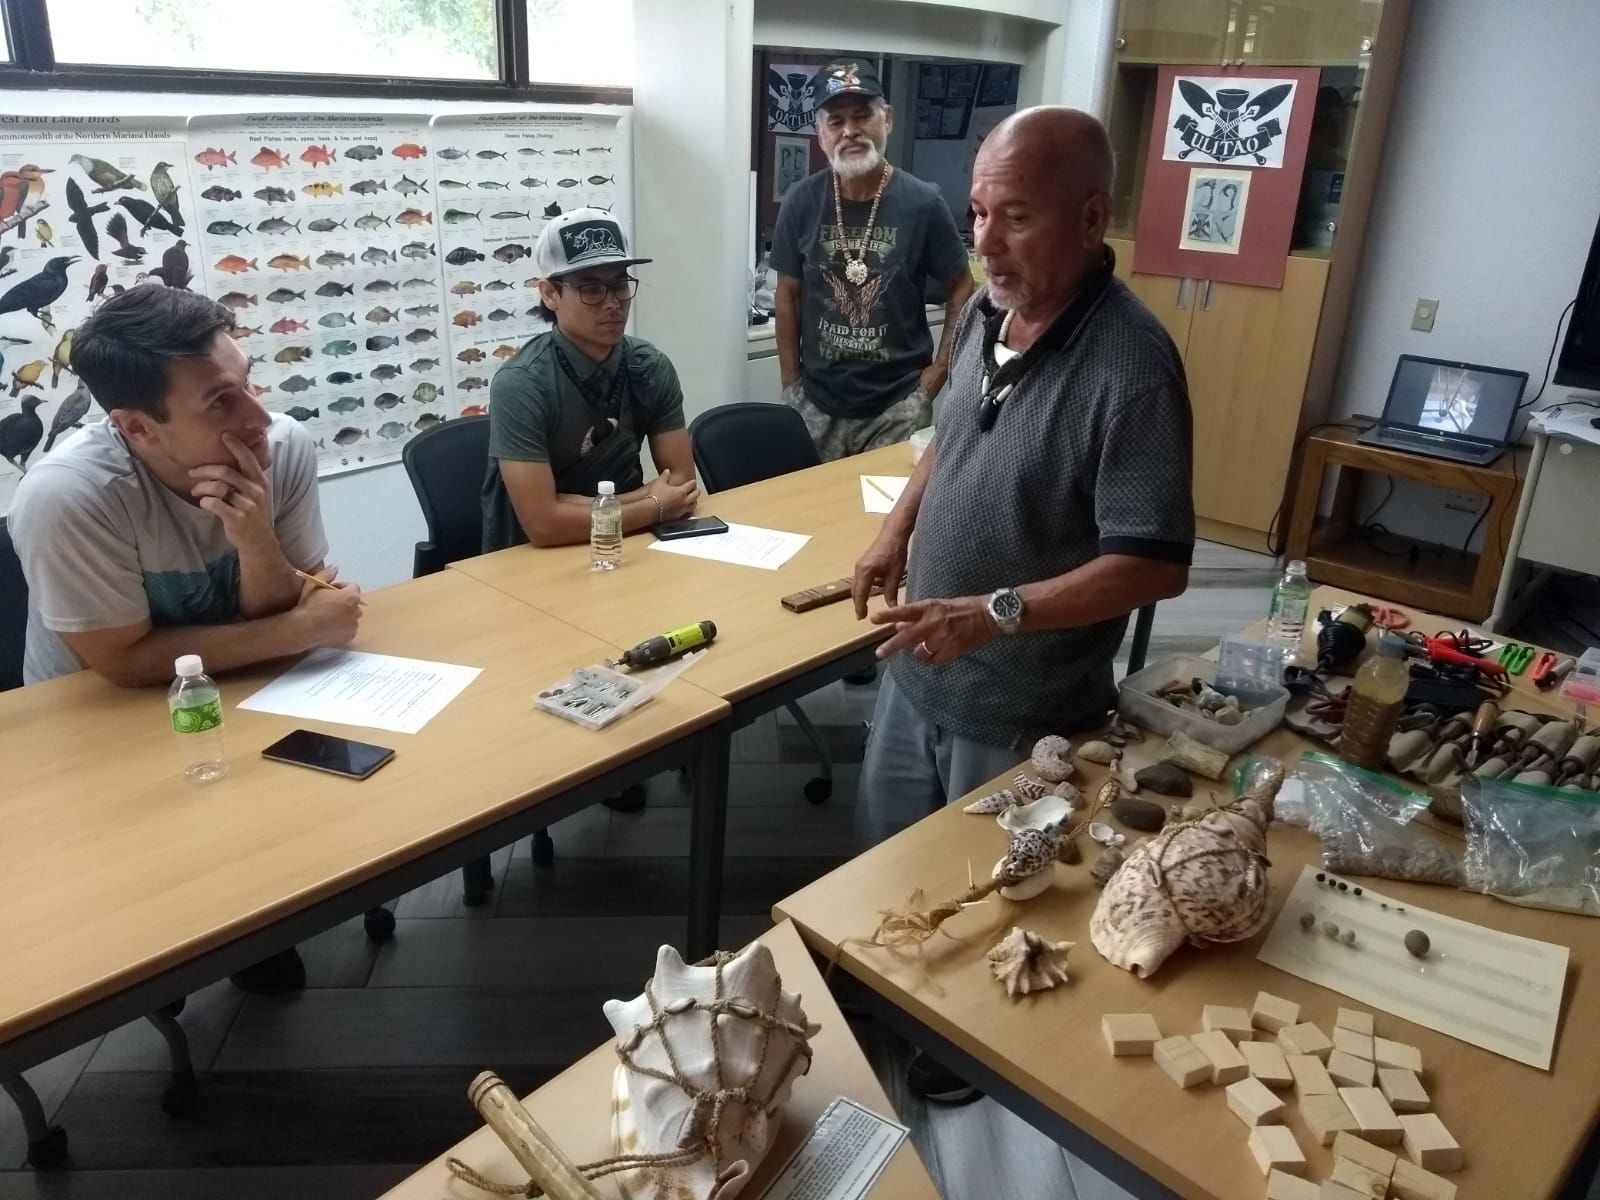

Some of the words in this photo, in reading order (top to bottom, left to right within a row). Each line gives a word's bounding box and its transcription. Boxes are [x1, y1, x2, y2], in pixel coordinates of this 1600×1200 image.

[0, 115, 19, 123] est
[23, 115, 48, 123] and
[52, 115, 84, 123] Land
[88, 115, 121, 123] Birds
[54, 132, 63, 140] of
[64, 132, 74, 140] the
[75, 131, 111, 140] Northern
[112, 131, 144, 140] Mariana
[144, 131, 171, 139] Islands
[1190, 132, 1259, 156] ULITAO
[823, 319, 850, 335] PAID
[852, 326, 876, 337] FOR
[879, 323, 889, 337] IT
